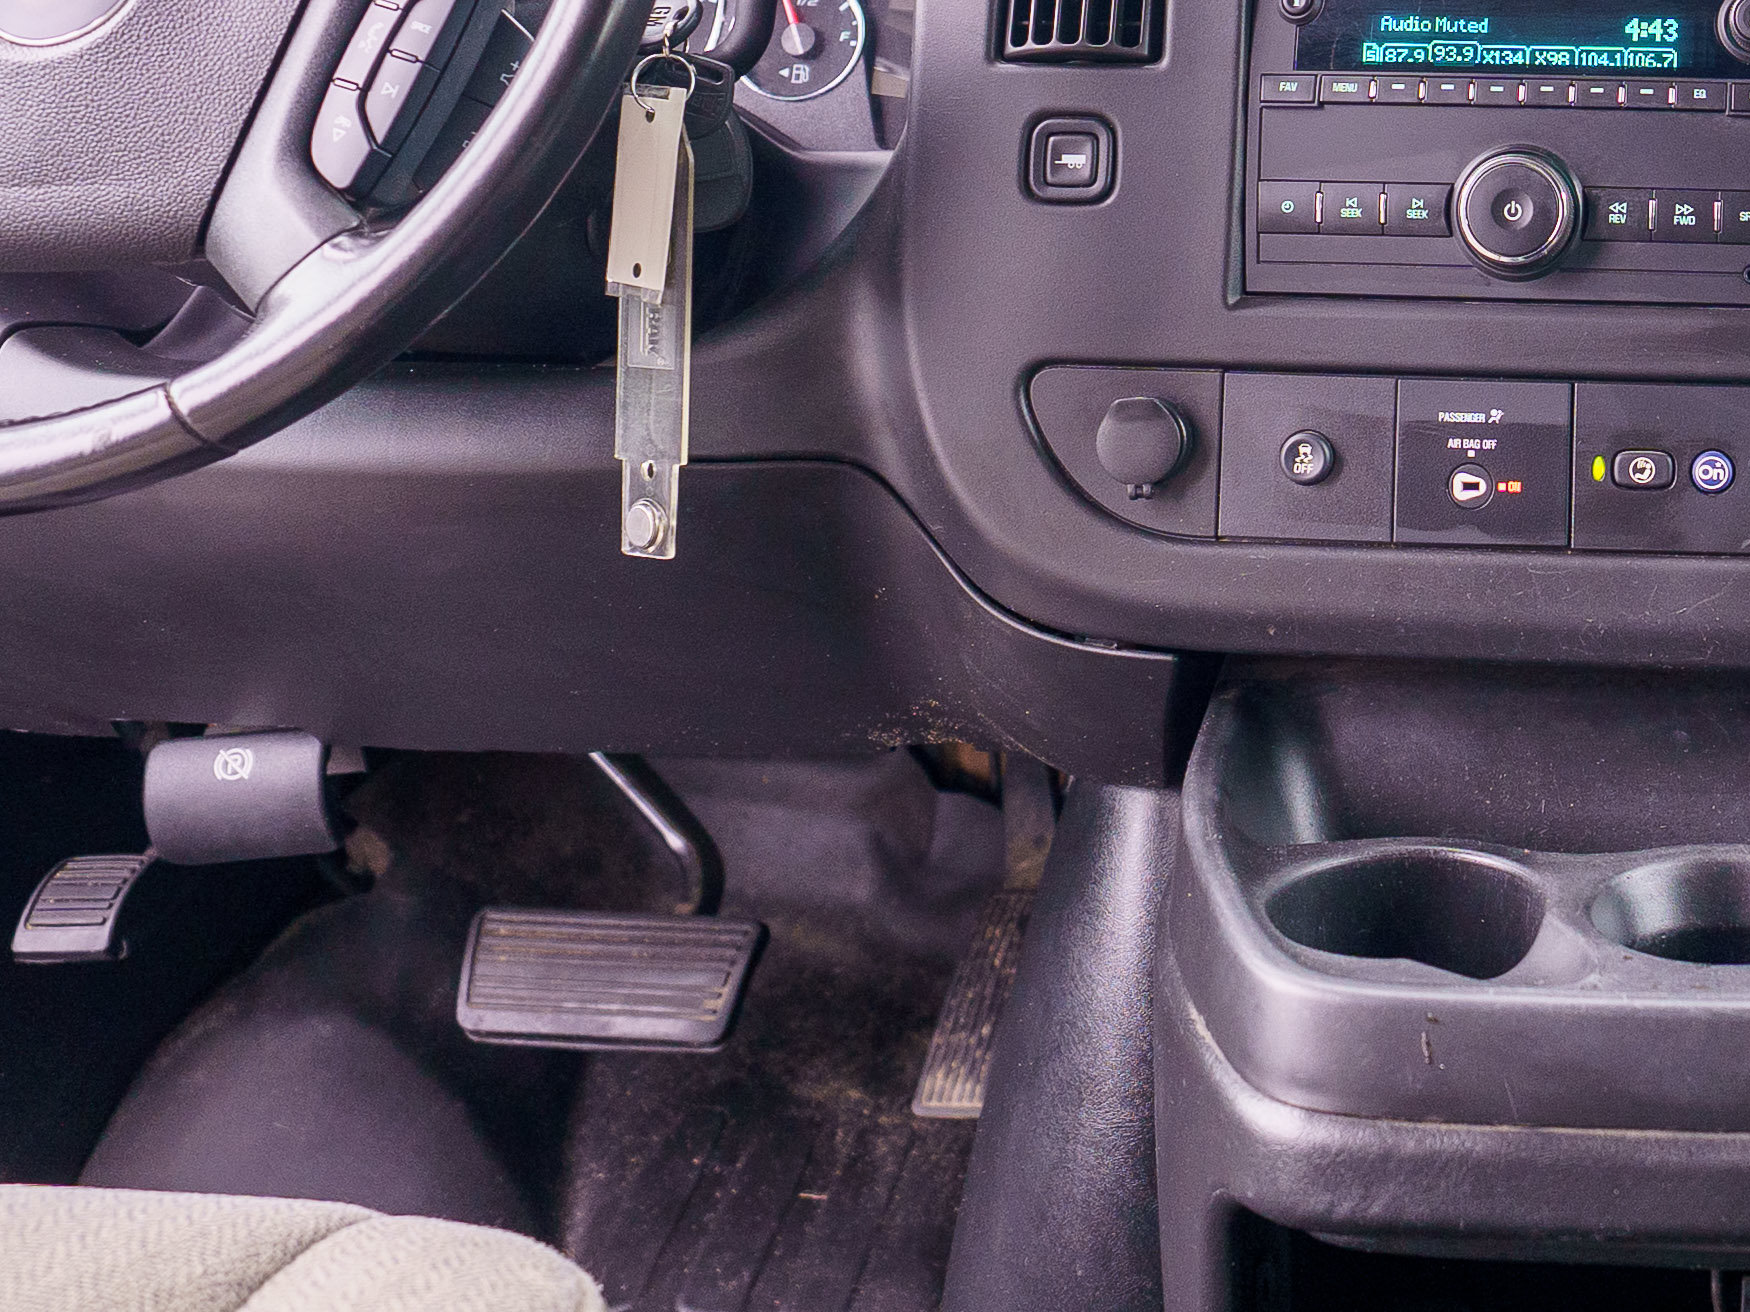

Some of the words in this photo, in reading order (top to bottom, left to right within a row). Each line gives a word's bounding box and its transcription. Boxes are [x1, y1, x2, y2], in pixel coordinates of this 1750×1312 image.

[1380, 16, 1432, 32] Audio
[1435, 17, 1489, 34] Muted
[1624, 18, 1679, 42] 4:43
[839, 31, 851, 42] F
[1384, 48, 1425, 63] 87.9
[1433, 45, 1474, 62] 93.9
[1482, 50, 1525, 65] X134
[1534, 50, 1570, 66] X98
[1580, 51, 1622, 67] 104.1
[1628, 52, 1673, 68] 106.7
[1279, 81, 1298, 92] FAV
[1332, 82, 1358, 93] MENU
[1693, 88, 1707, 99] EQ
[1340, 207, 1363, 218] SEEK
[1406, 208, 1429, 219] SEEK
[1608, 213, 1628, 224] REV
[1673, 215, 1696, 226] FWD
[1438, 411, 1486, 423] PASSENGER
[1447, 438, 1461, 449] AIR
[1462, 438, 1481, 449] BAG
[1482, 439, 1498, 450] OFF
[1293, 462, 1314, 474] OFF
[1698, 463, 1726, 481] On
[1507, 481, 1522, 493] ON
